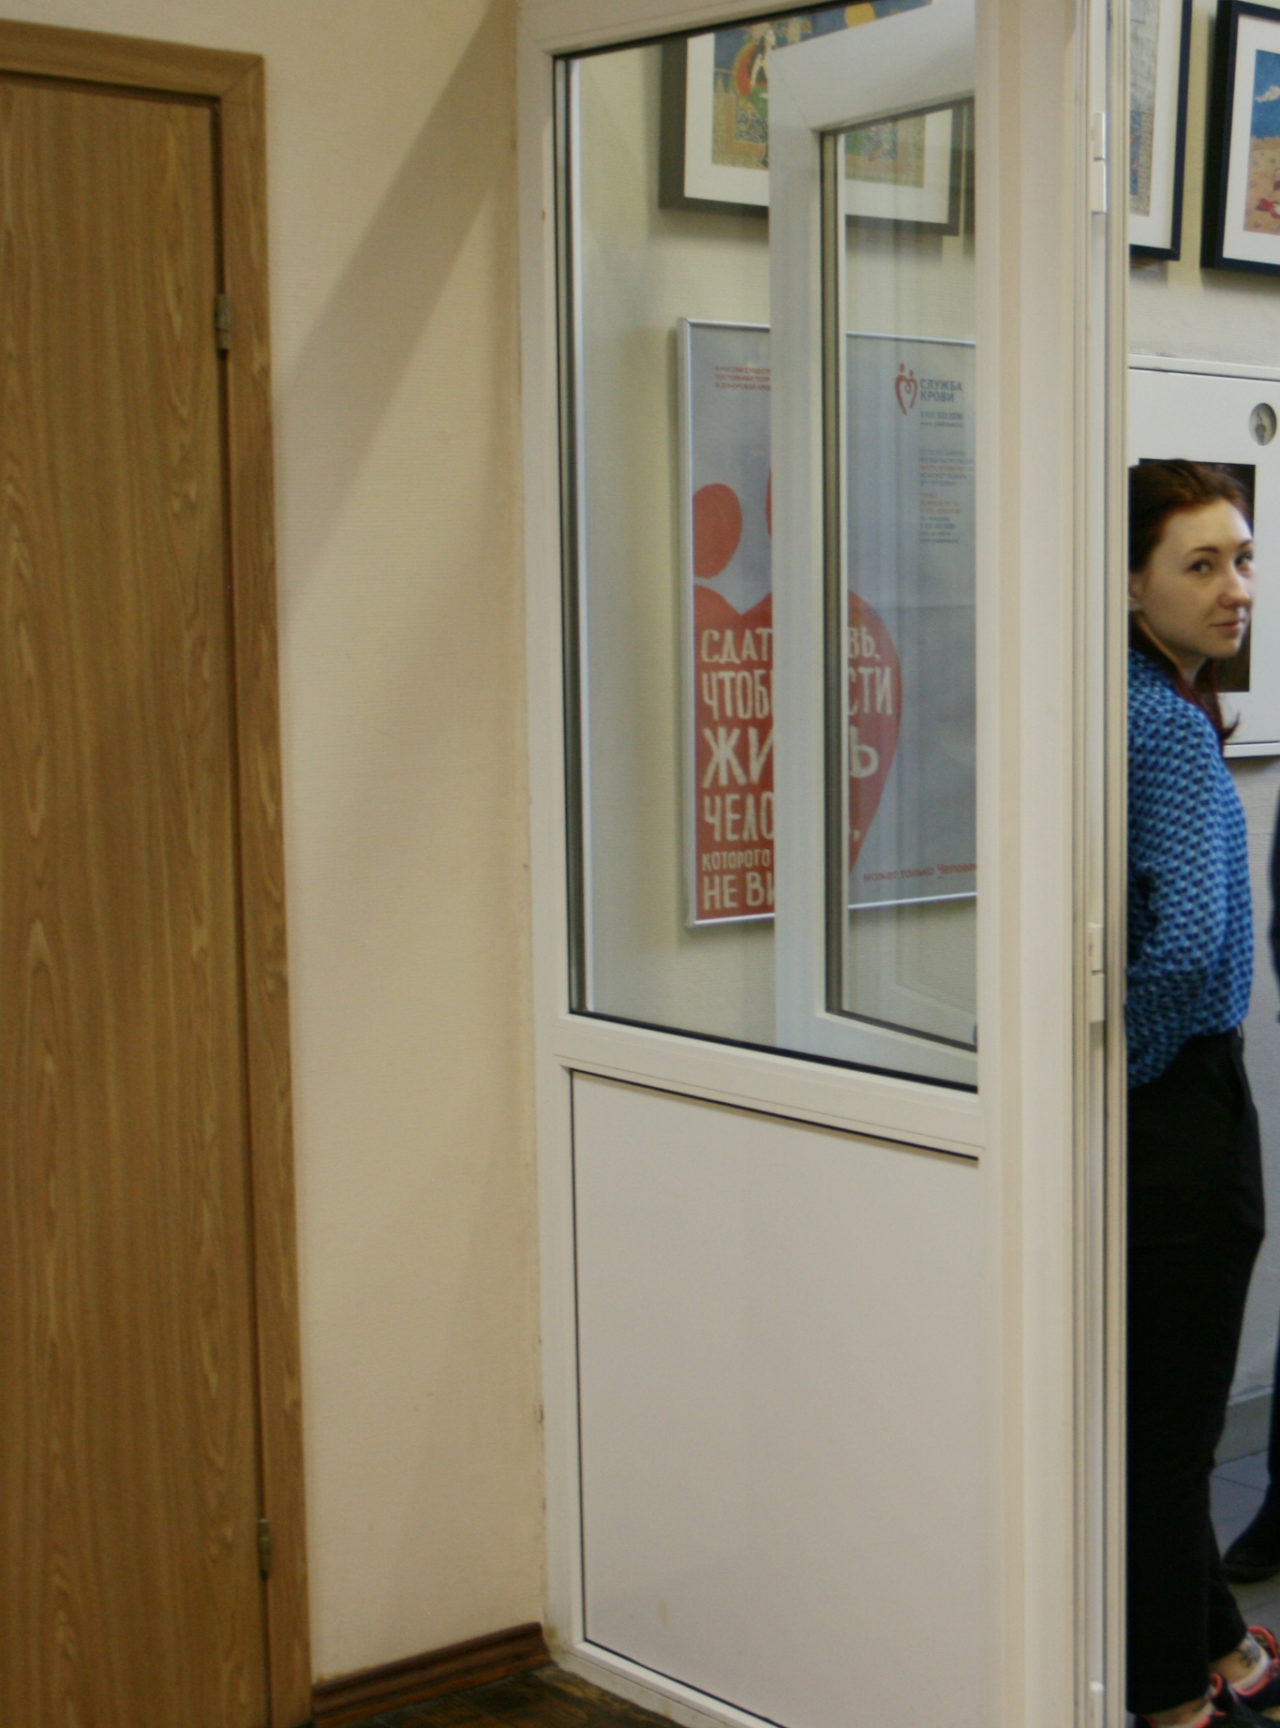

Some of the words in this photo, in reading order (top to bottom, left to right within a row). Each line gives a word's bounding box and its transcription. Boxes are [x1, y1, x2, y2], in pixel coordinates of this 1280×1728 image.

[919, 378, 963, 391] СЛУЖБА
[919, 390, 955, 402] КРОВИ
[701, 627, 773, 664] СДАТ
[701, 668, 773, 720] ЧТОБ
[702, 848, 771, 871] КОТОРОГО
[703, 874, 740, 911] НЕ
